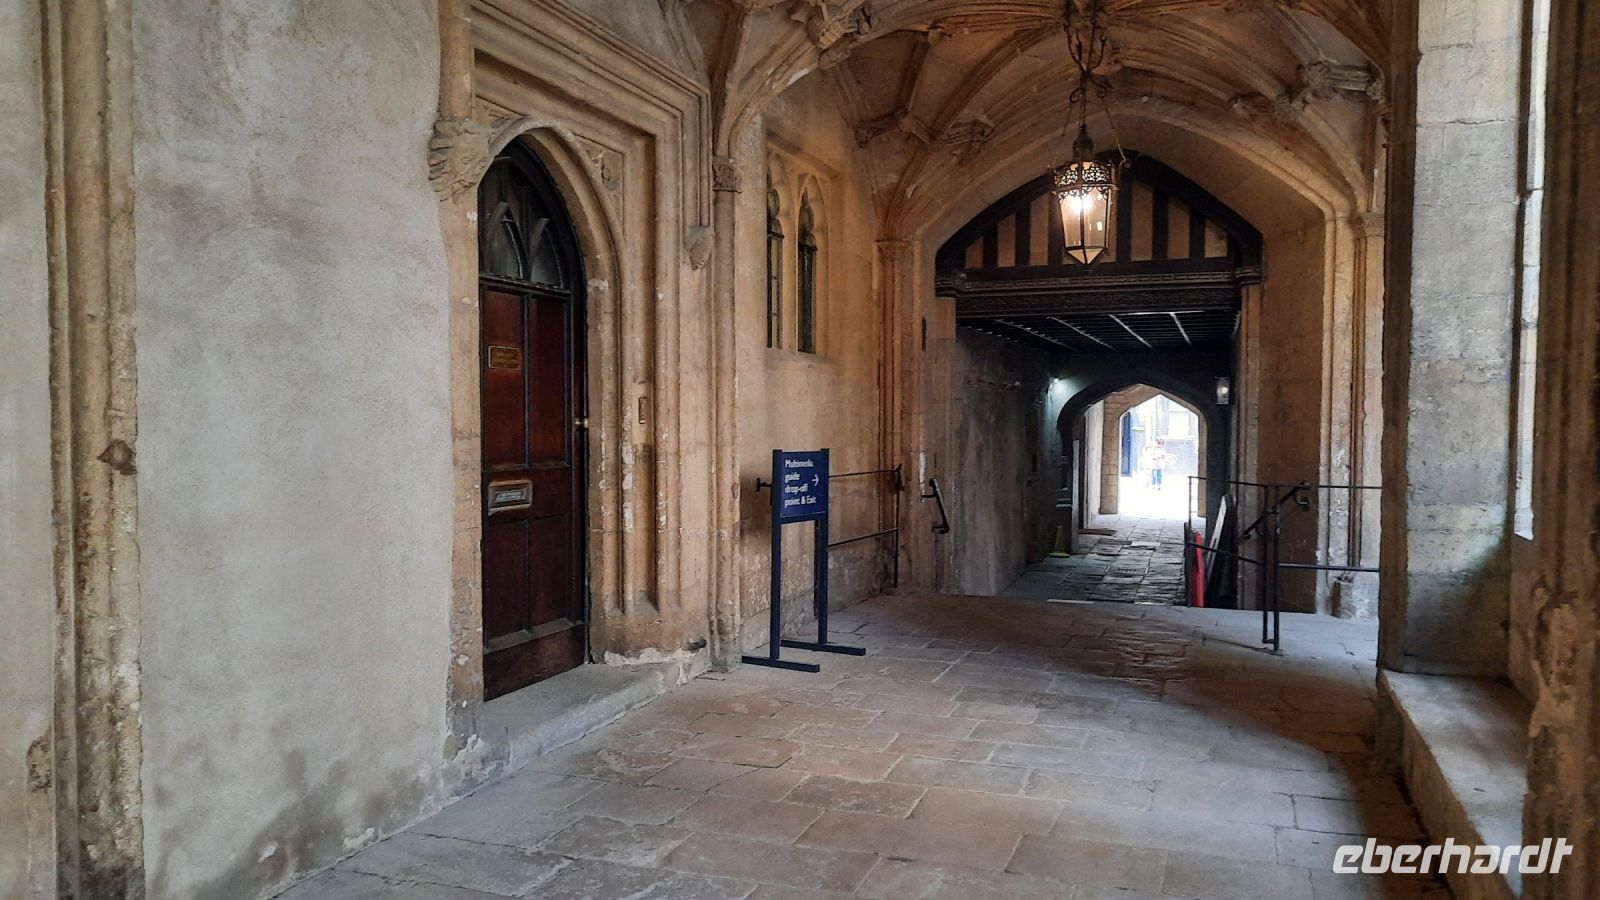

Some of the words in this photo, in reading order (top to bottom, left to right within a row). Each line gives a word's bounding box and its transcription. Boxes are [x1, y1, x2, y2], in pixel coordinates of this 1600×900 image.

[785, 459, 813, 468] Multimedia
[784, 472, 800, 483] guide
[784, 483, 808, 495] drop-off
[784, 497, 800, 508] point
[801, 496, 806, 504] &
[806, 495, 817, 504] Exit
